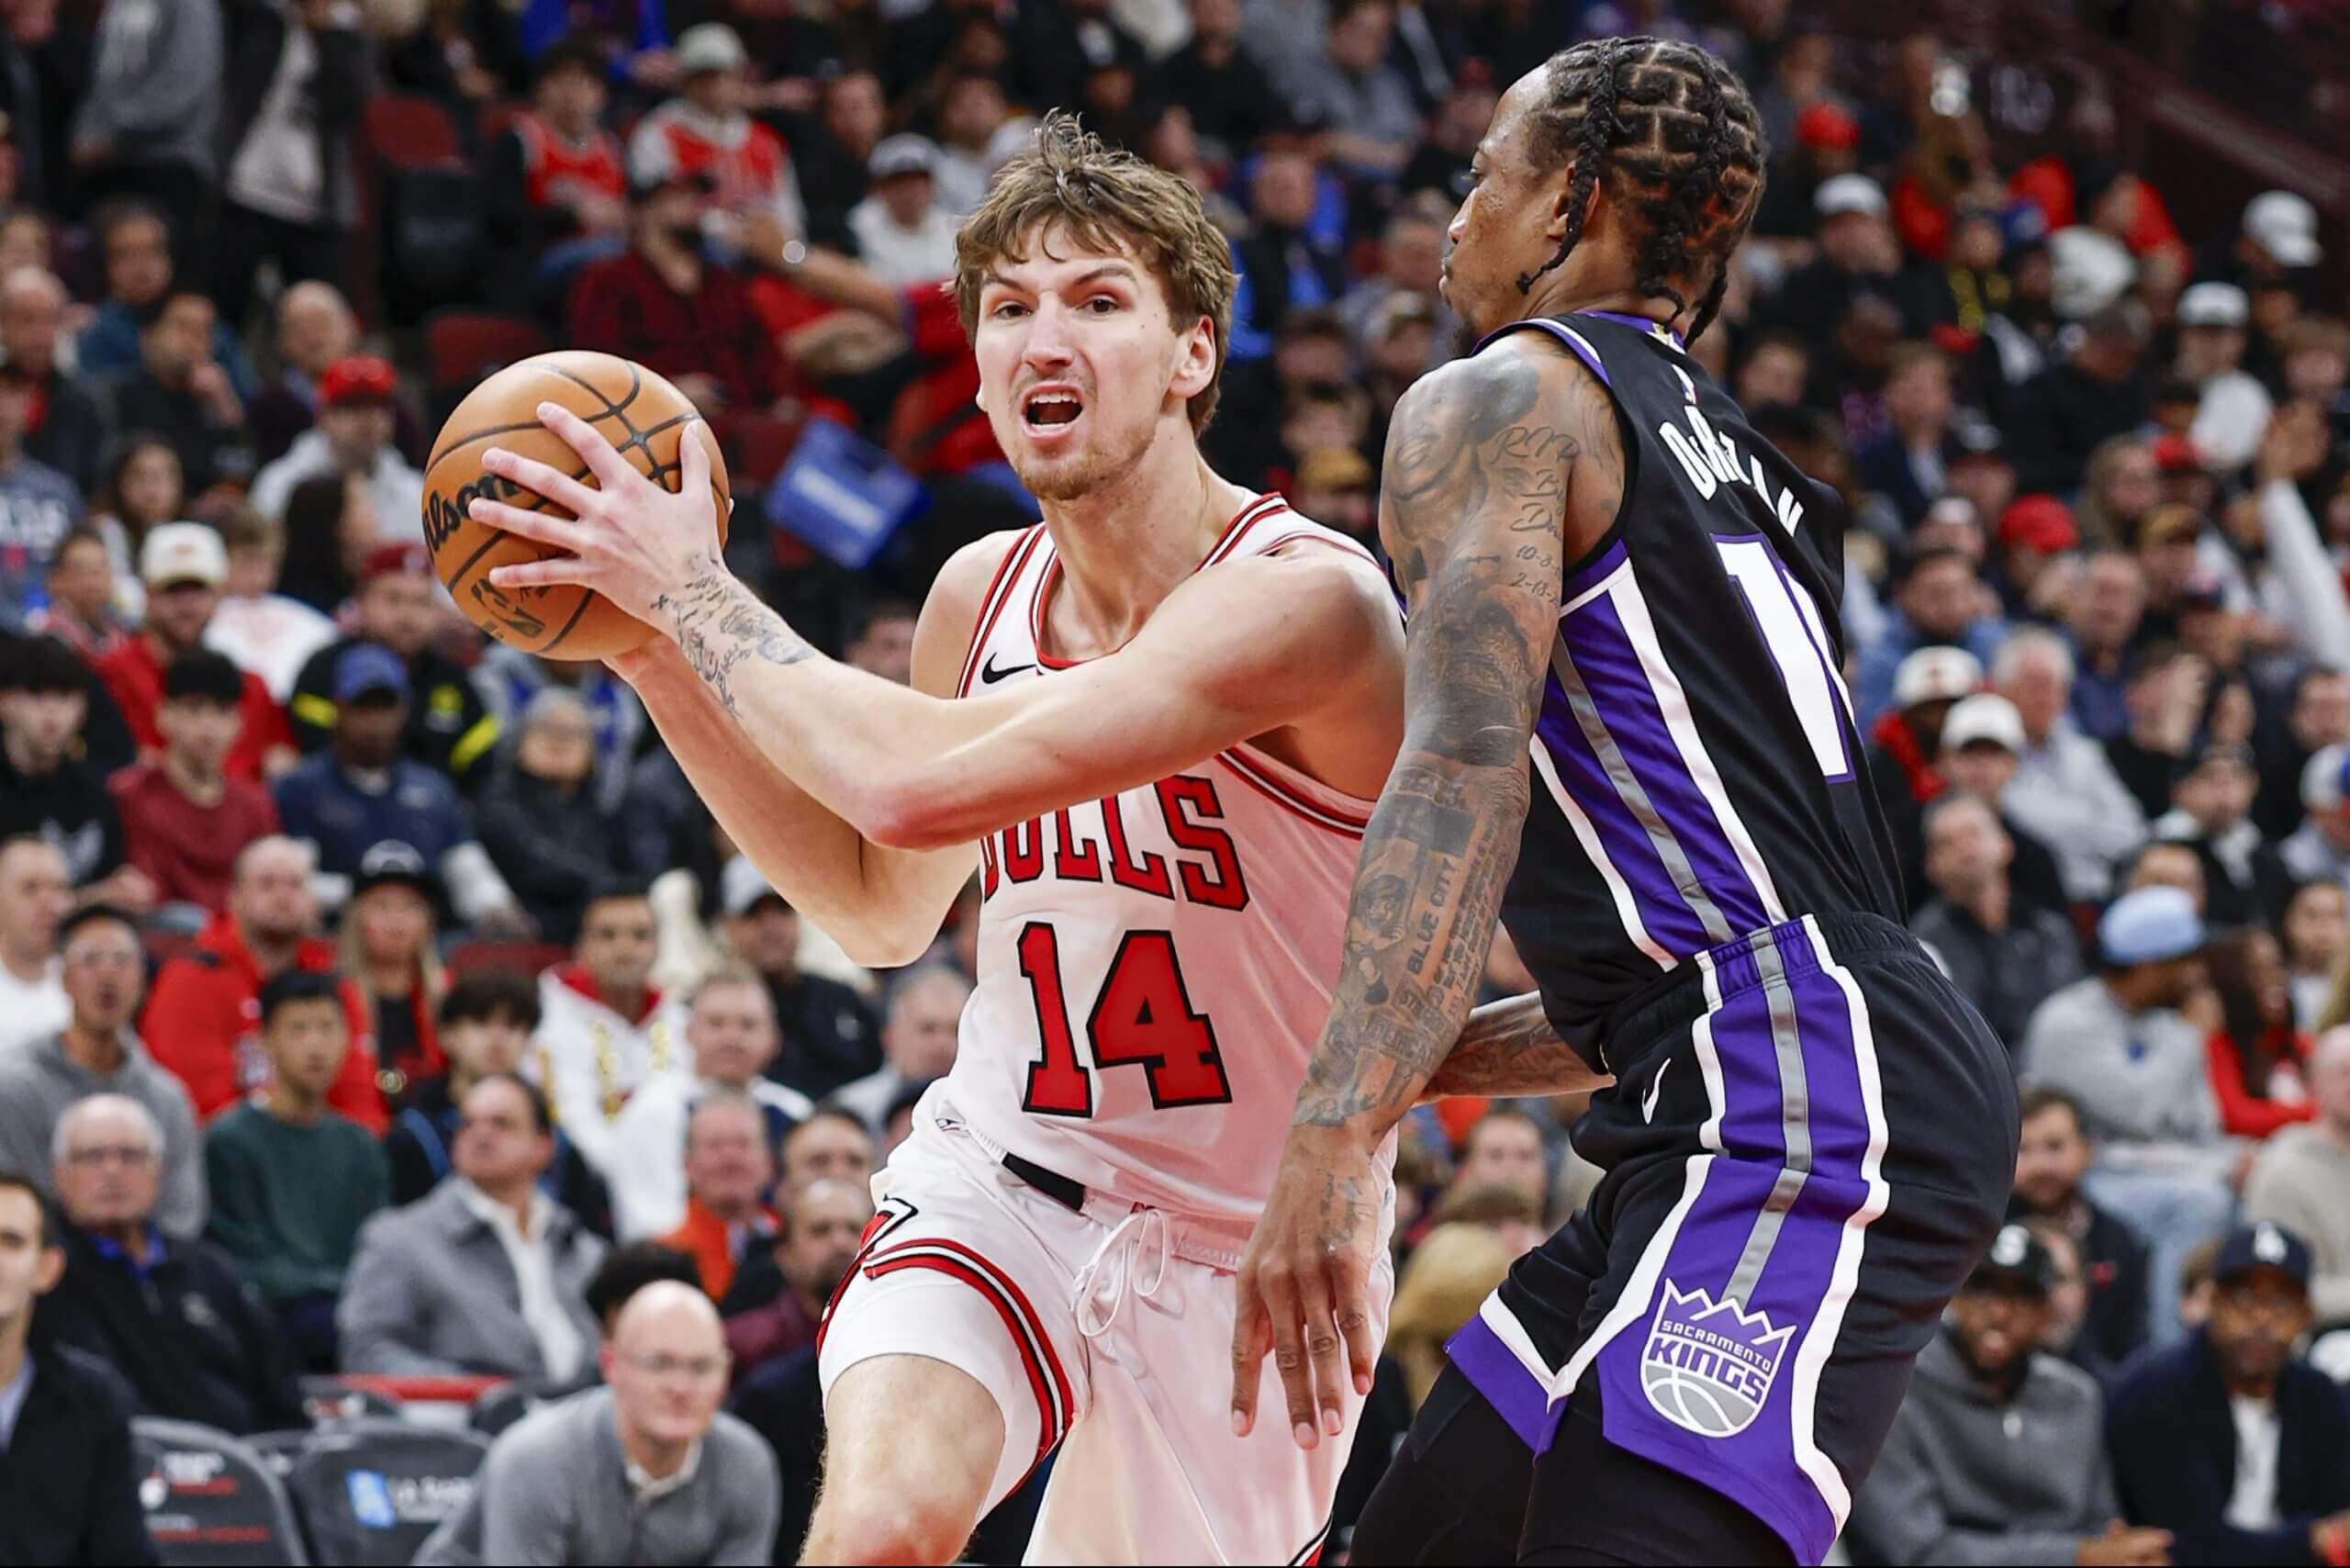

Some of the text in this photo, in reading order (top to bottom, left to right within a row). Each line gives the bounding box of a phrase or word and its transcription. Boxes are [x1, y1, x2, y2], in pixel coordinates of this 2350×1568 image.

[1017, 922, 1233, 1118] 14
[1647, 1336, 1768, 1406] KINGS
[1661, 1319, 1773, 1372] SACRAMENTO
